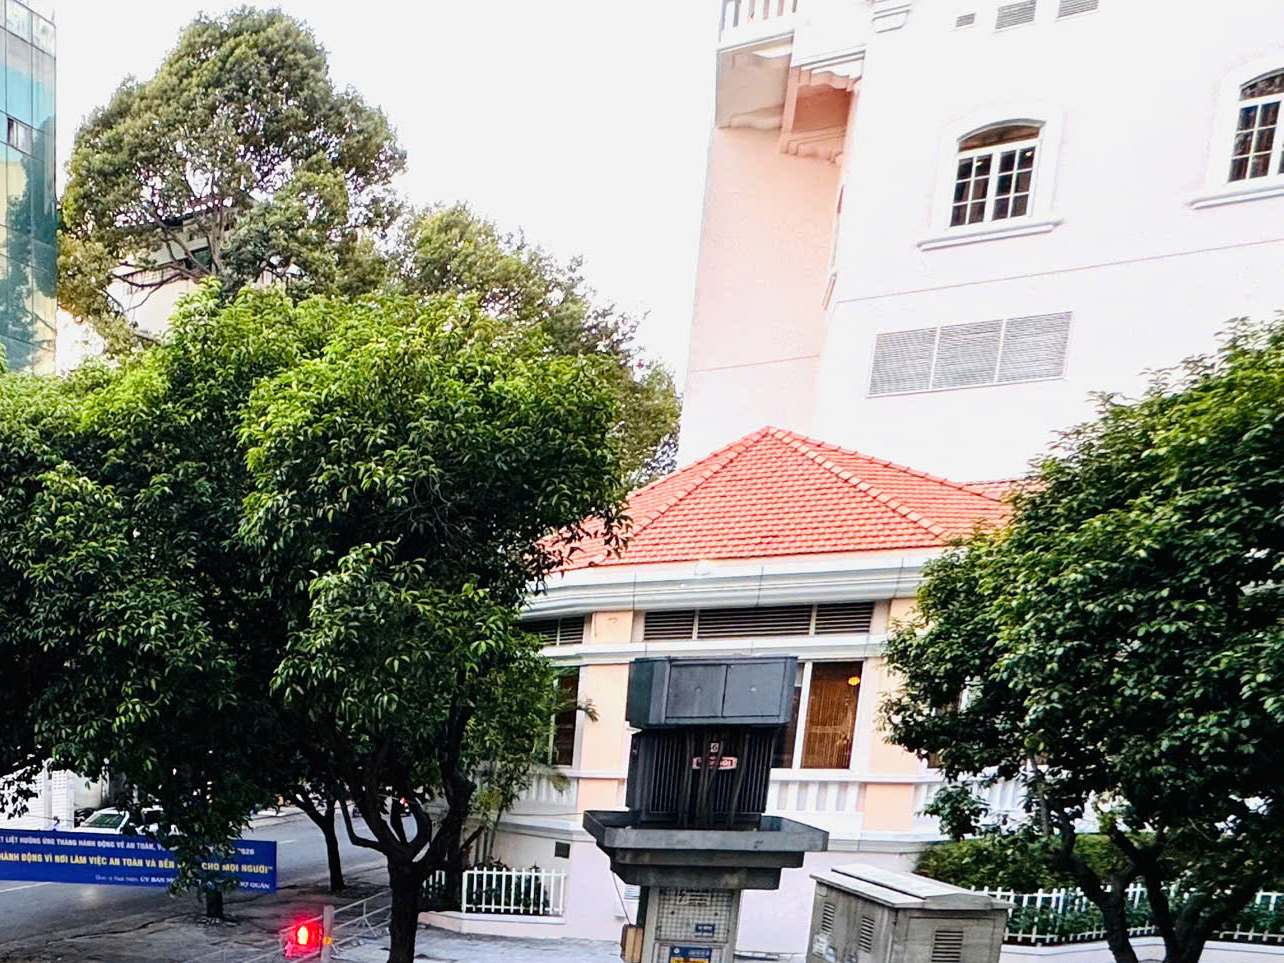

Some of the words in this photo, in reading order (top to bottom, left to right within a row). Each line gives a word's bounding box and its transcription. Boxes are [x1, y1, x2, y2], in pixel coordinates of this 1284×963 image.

[20, 851, 43, 864] ĐỘNG
[44, 852, 53, 863] VÌ
[70, 853, 87, 865] LÀM
[88, 855, 107, 867] VIỆC
[109, 857, 121, 866] AN
[122, 857, 143, 868] TOÀN
[145, 858, 157, 868] VÀ
[201, 862, 220, 871] CHO
